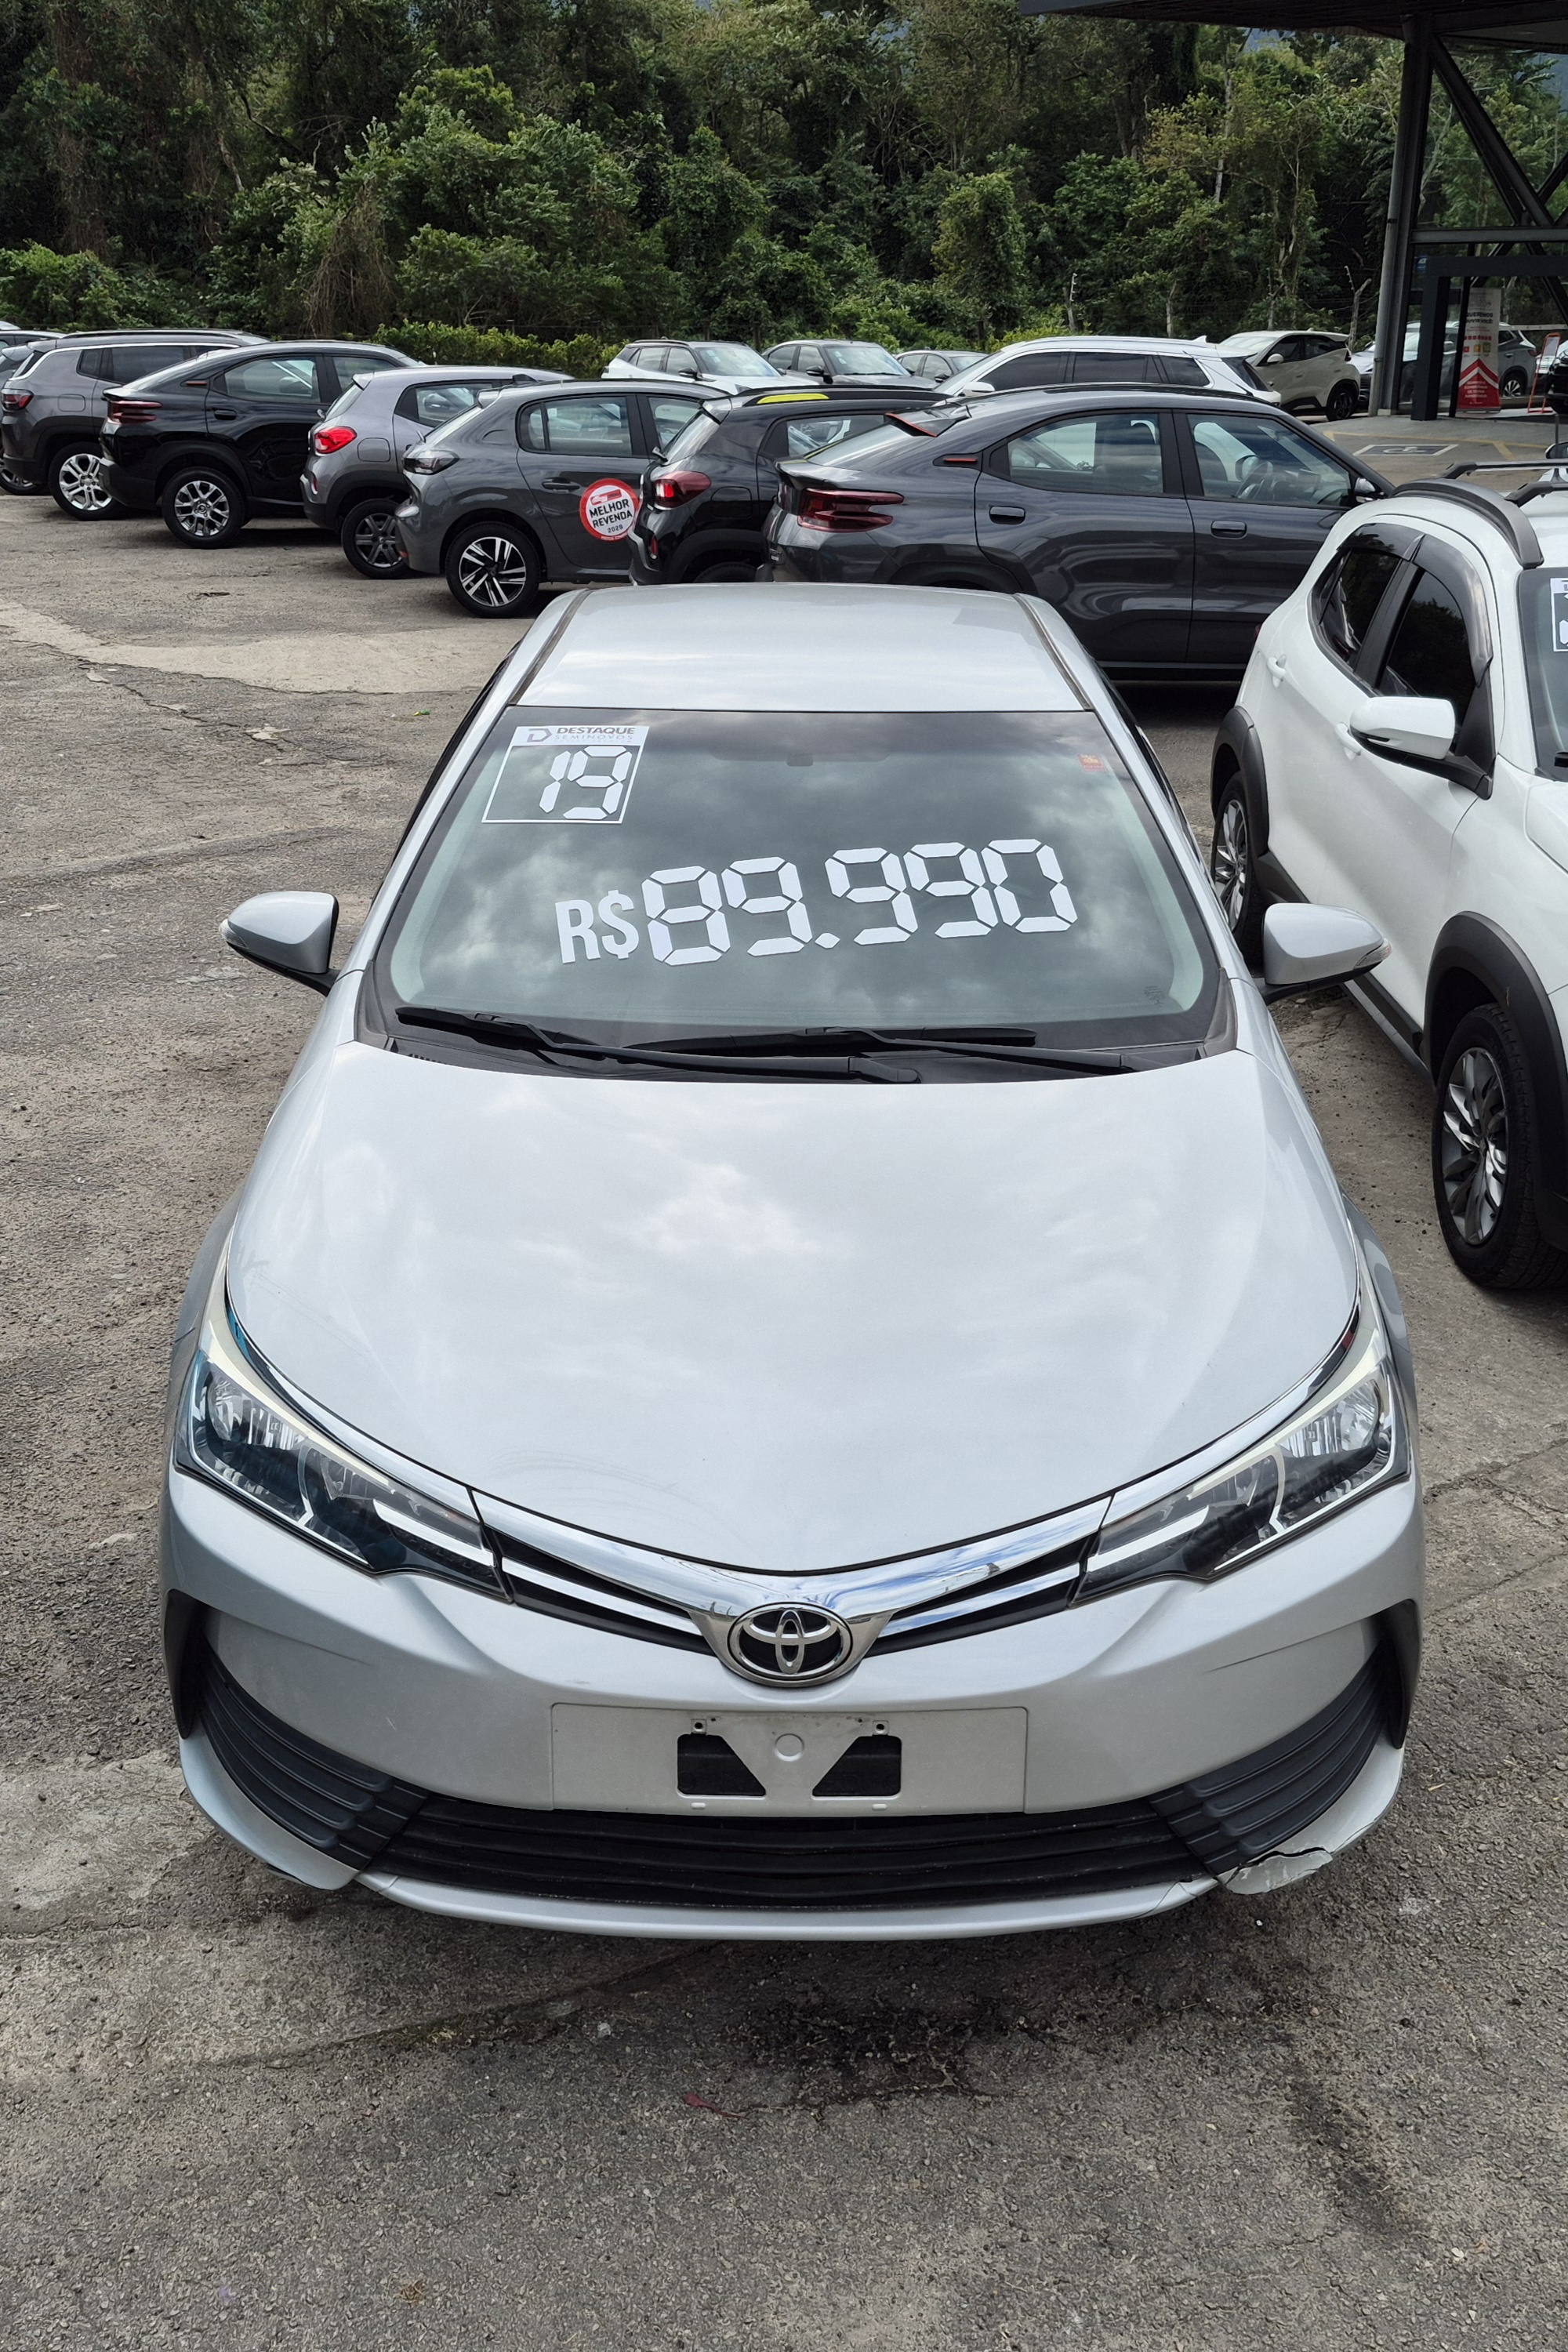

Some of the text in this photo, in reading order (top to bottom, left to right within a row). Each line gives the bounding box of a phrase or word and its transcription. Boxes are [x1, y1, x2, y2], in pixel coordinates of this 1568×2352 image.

[589, 499, 630, 518] MELHOR
[592, 510, 633, 528] REVENDA
[539, 746, 633, 820] 19
